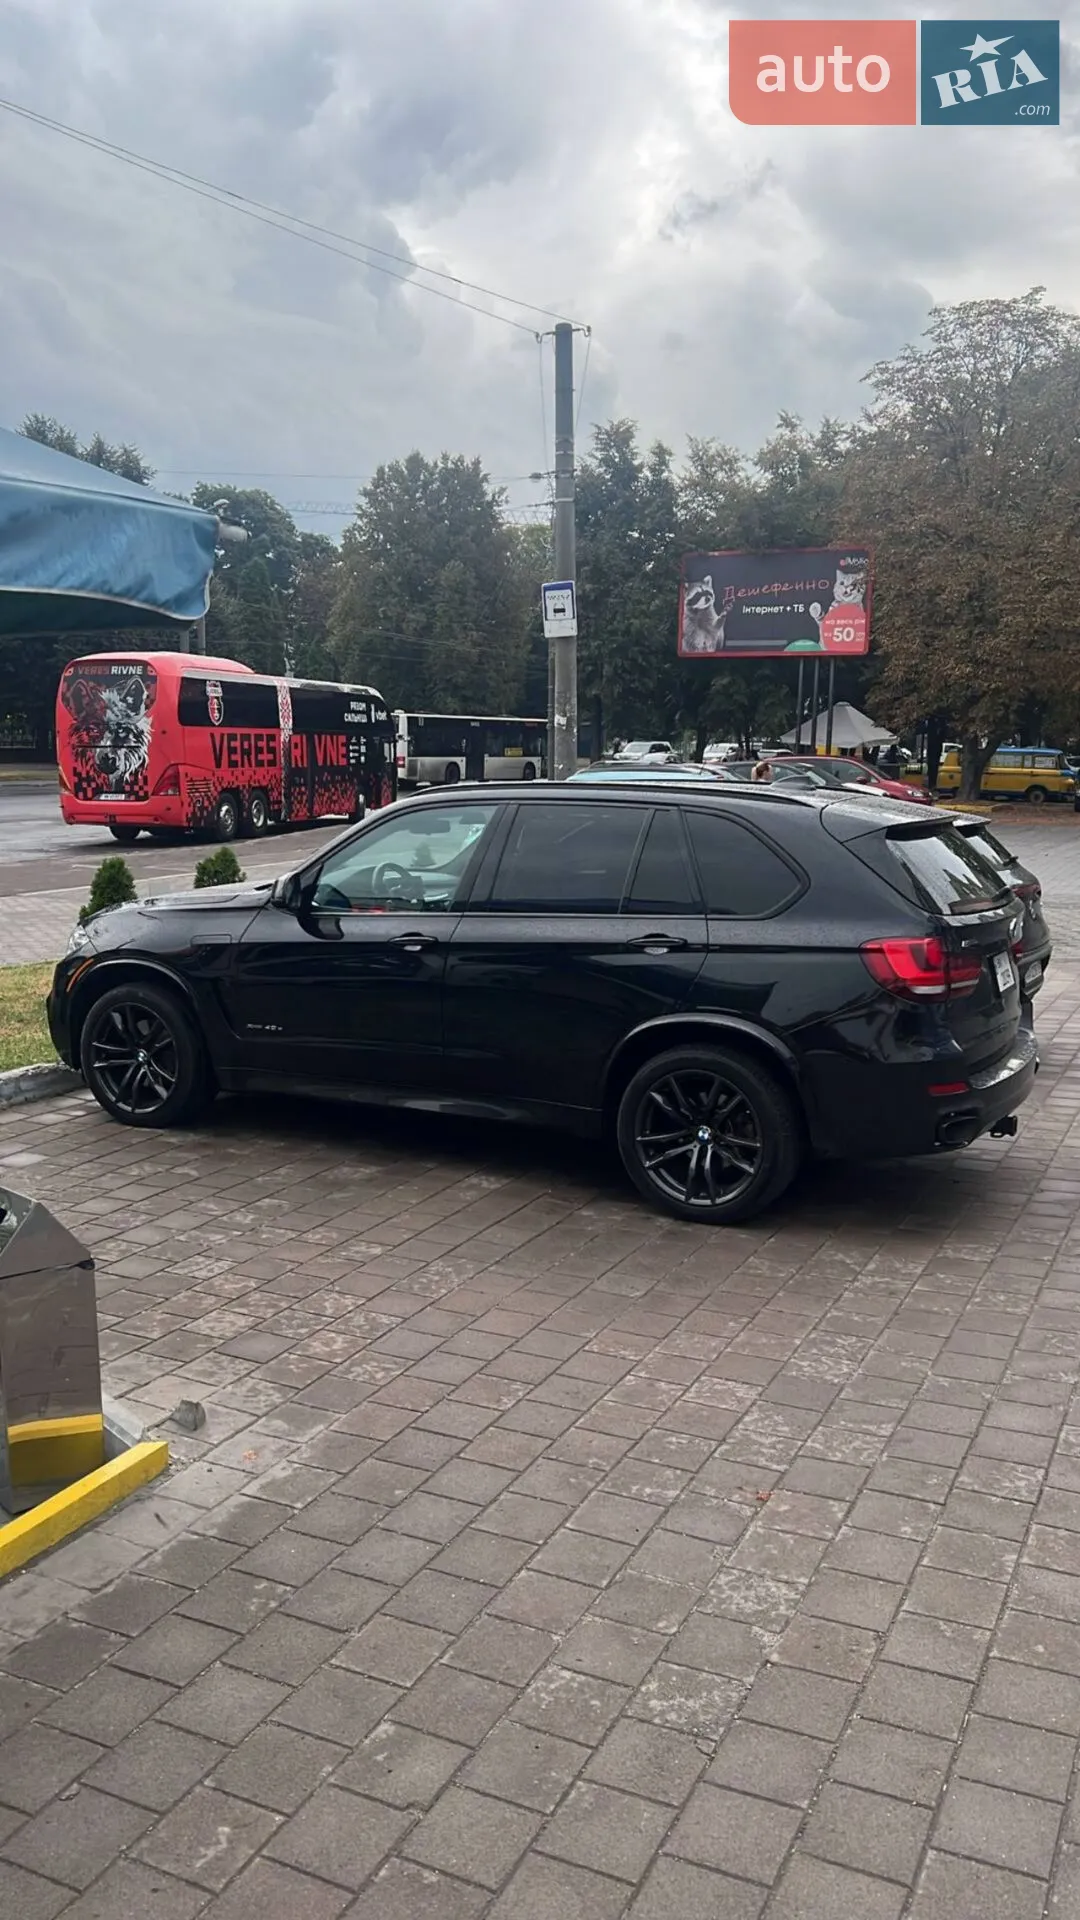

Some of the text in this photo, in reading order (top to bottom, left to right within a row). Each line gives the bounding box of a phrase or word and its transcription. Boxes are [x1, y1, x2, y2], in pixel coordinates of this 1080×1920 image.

[742, 605, 784, 615] Інтернет
[793, 603, 805, 613] ТБ
[832, 627, 855, 642] 50
[78, 665, 143, 675] VERES RIVNE
[209, 732, 277, 769] VERES
